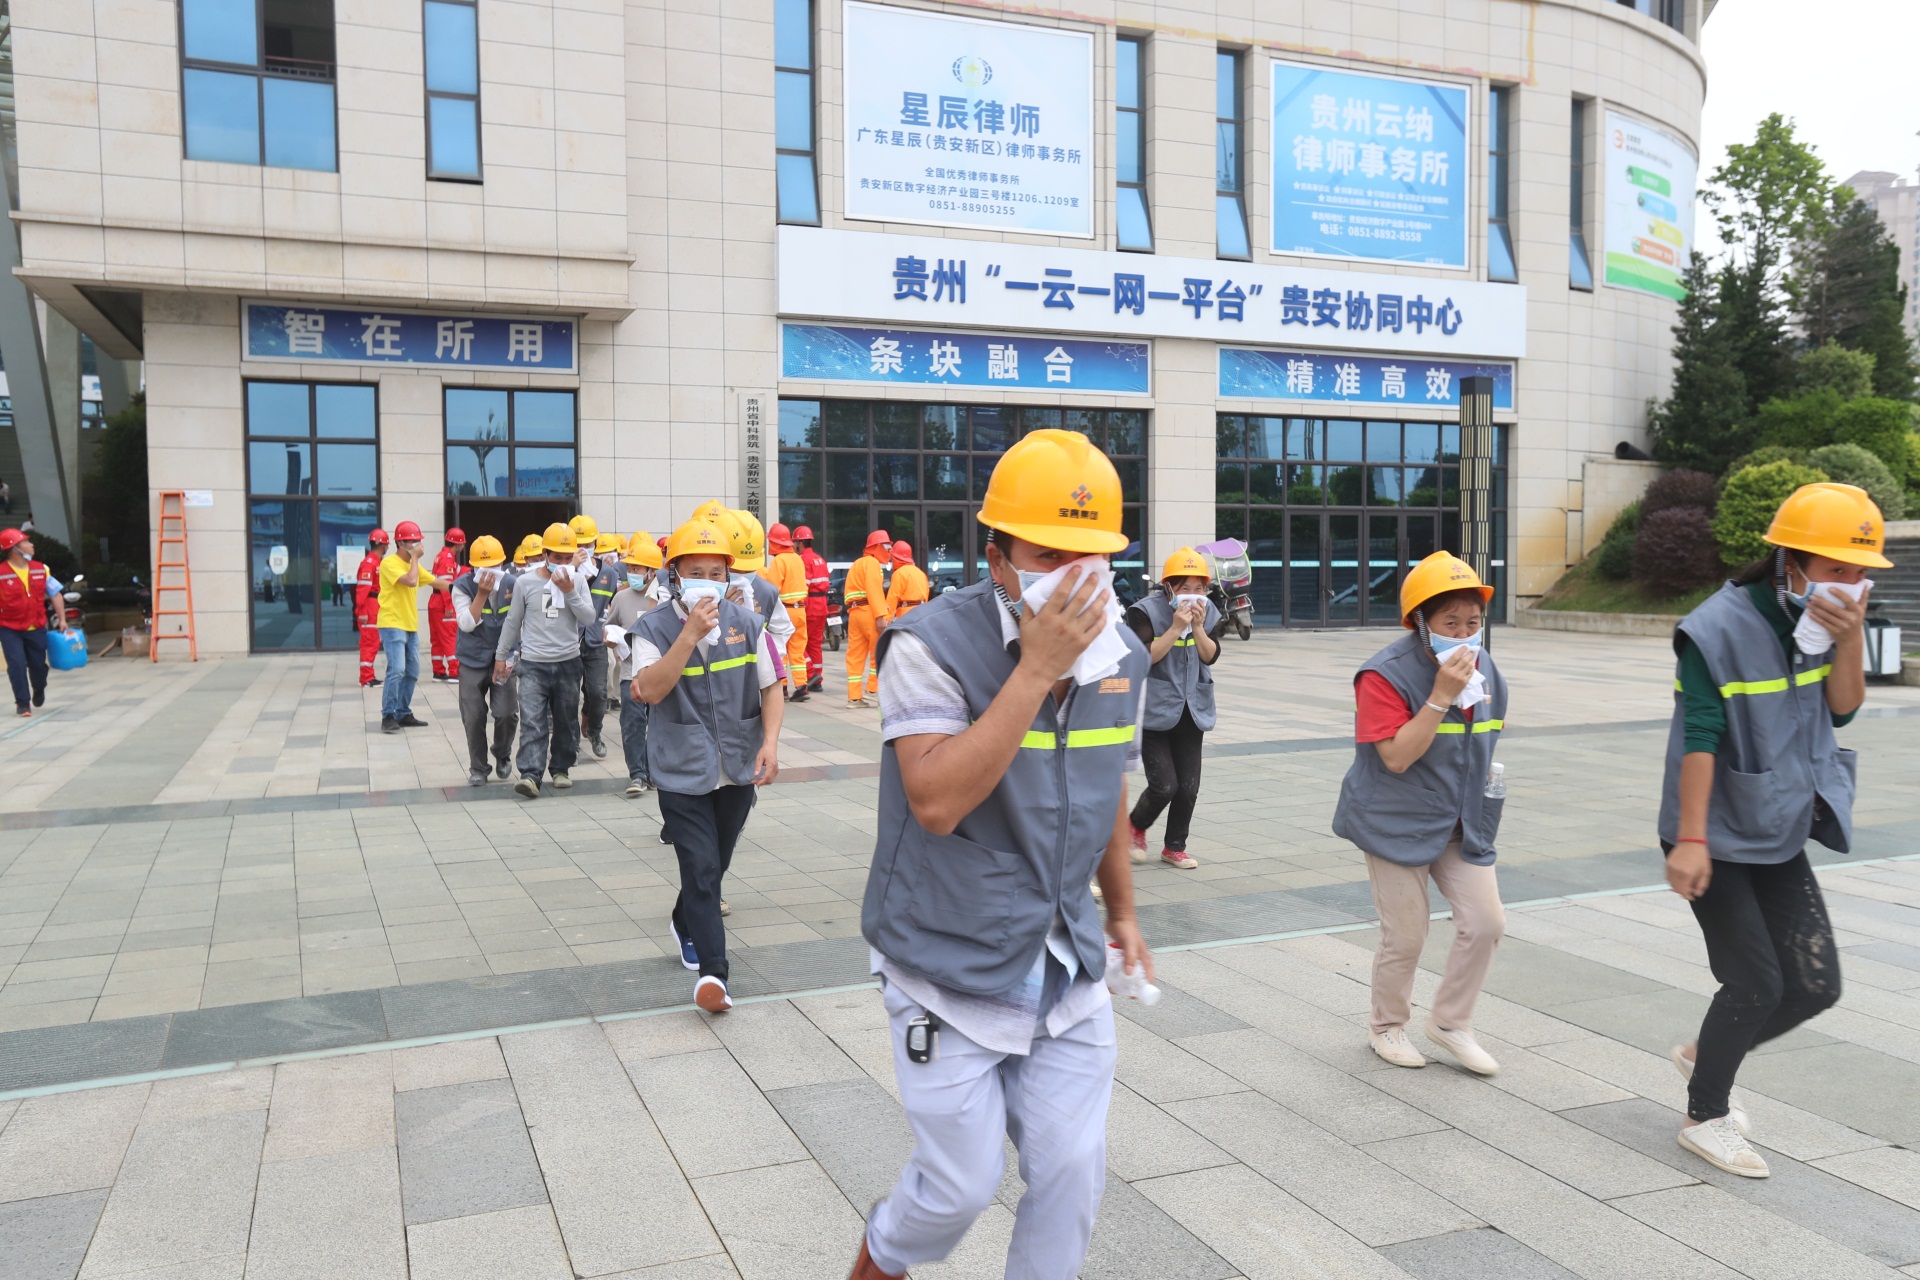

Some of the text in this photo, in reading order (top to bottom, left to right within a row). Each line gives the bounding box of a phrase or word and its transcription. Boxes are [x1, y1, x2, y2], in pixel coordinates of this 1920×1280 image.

[900, 91, 1040, 138] 星辰律师
[1310, 94, 1434, 143] 贵州云纳
[924, 167, 1020, 185] 全国优秀律师事务所
[1293, 135, 1449, 186] 律师事务所
[929, 200, 1015, 215] 0851-88905255
[284, 310, 543, 363] 智在所用
[870, 337, 1074, 383] 条块融合
[1286, 359, 1451, 400] 精准高效
